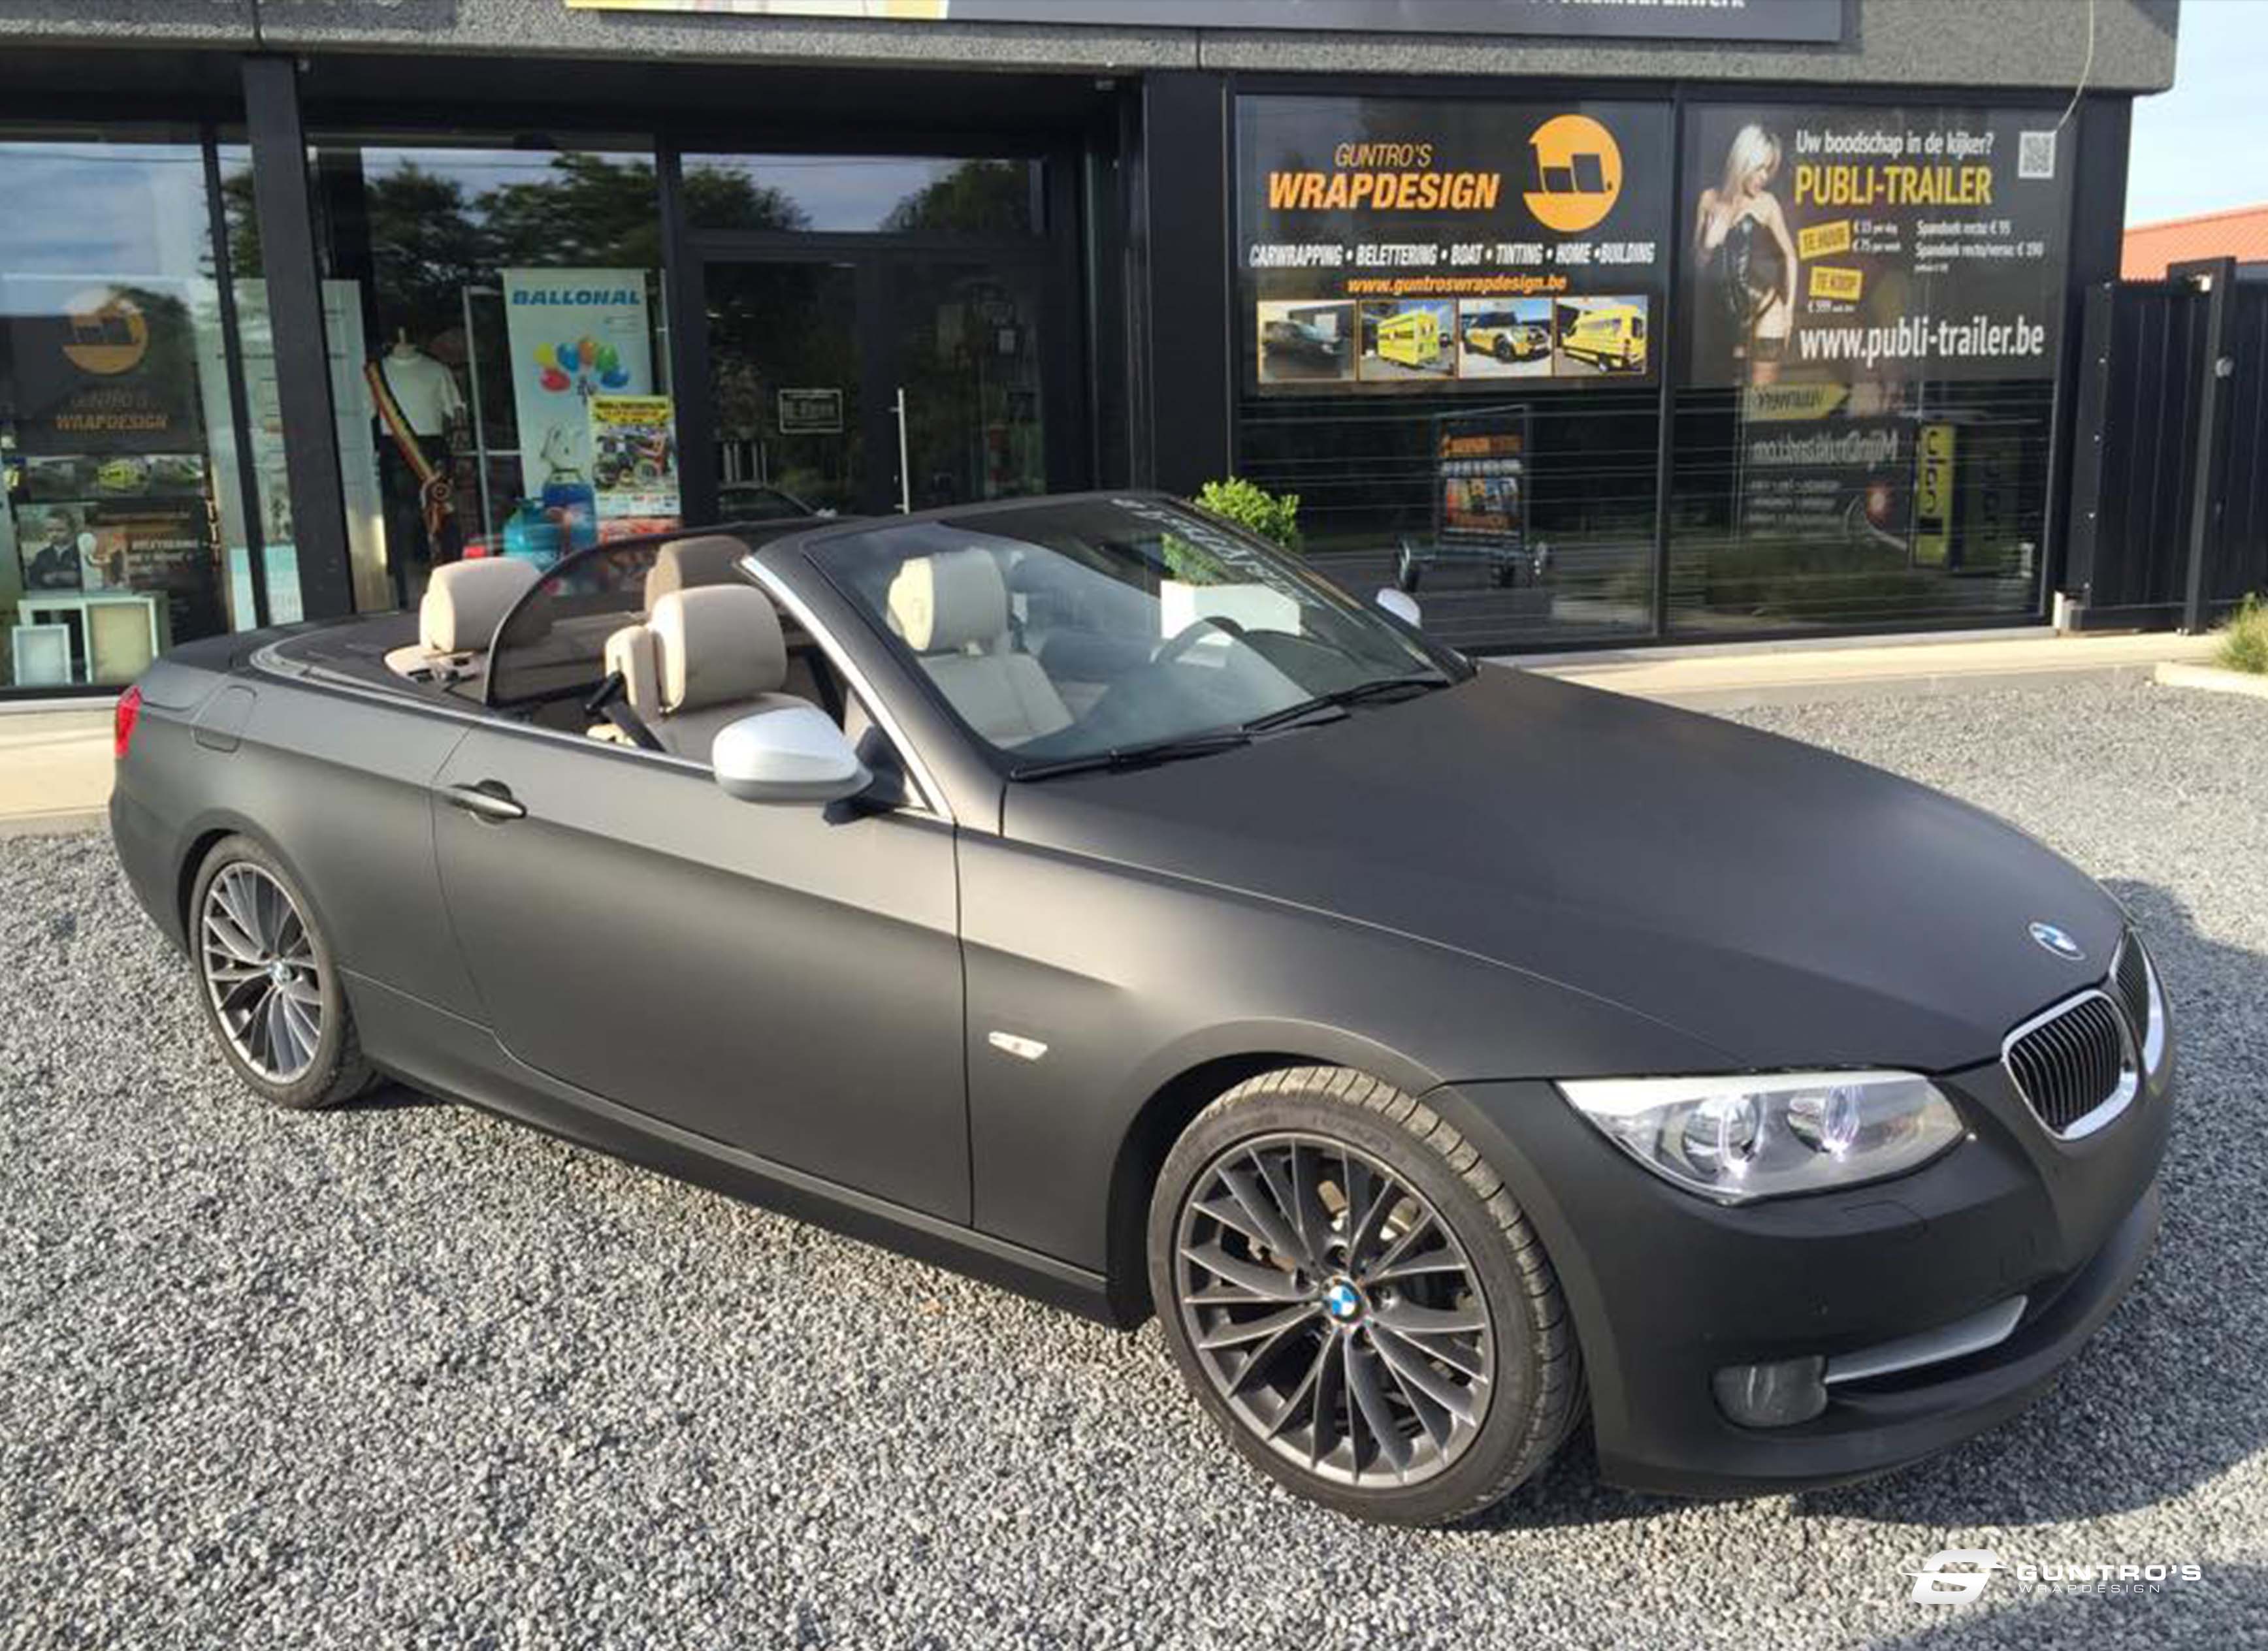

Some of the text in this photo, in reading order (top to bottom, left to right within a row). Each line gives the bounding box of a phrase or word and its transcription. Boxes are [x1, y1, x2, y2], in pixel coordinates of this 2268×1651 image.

[1335, 142, 1433, 168] GUNTRO'S
[1796, 131, 1994, 159] Uw boodschap in de kijker?
[1269, 172, 1500, 210] WRAPDESIGN
[1795, 166, 1993, 206] PUBLI-TRAILER
[1249, 242, 1655, 268] CARWRAPPING BELETTERING BOAT TINTING HOME BUILDING
[512, 289, 640, 306] BALLONAL
[1348, 274, 1566, 295] www.guntroswrapdesign.be
[1800, 315, 2045, 368] www.publi-trailer.be
[56, 413, 169, 430] WRAPDESIGN
